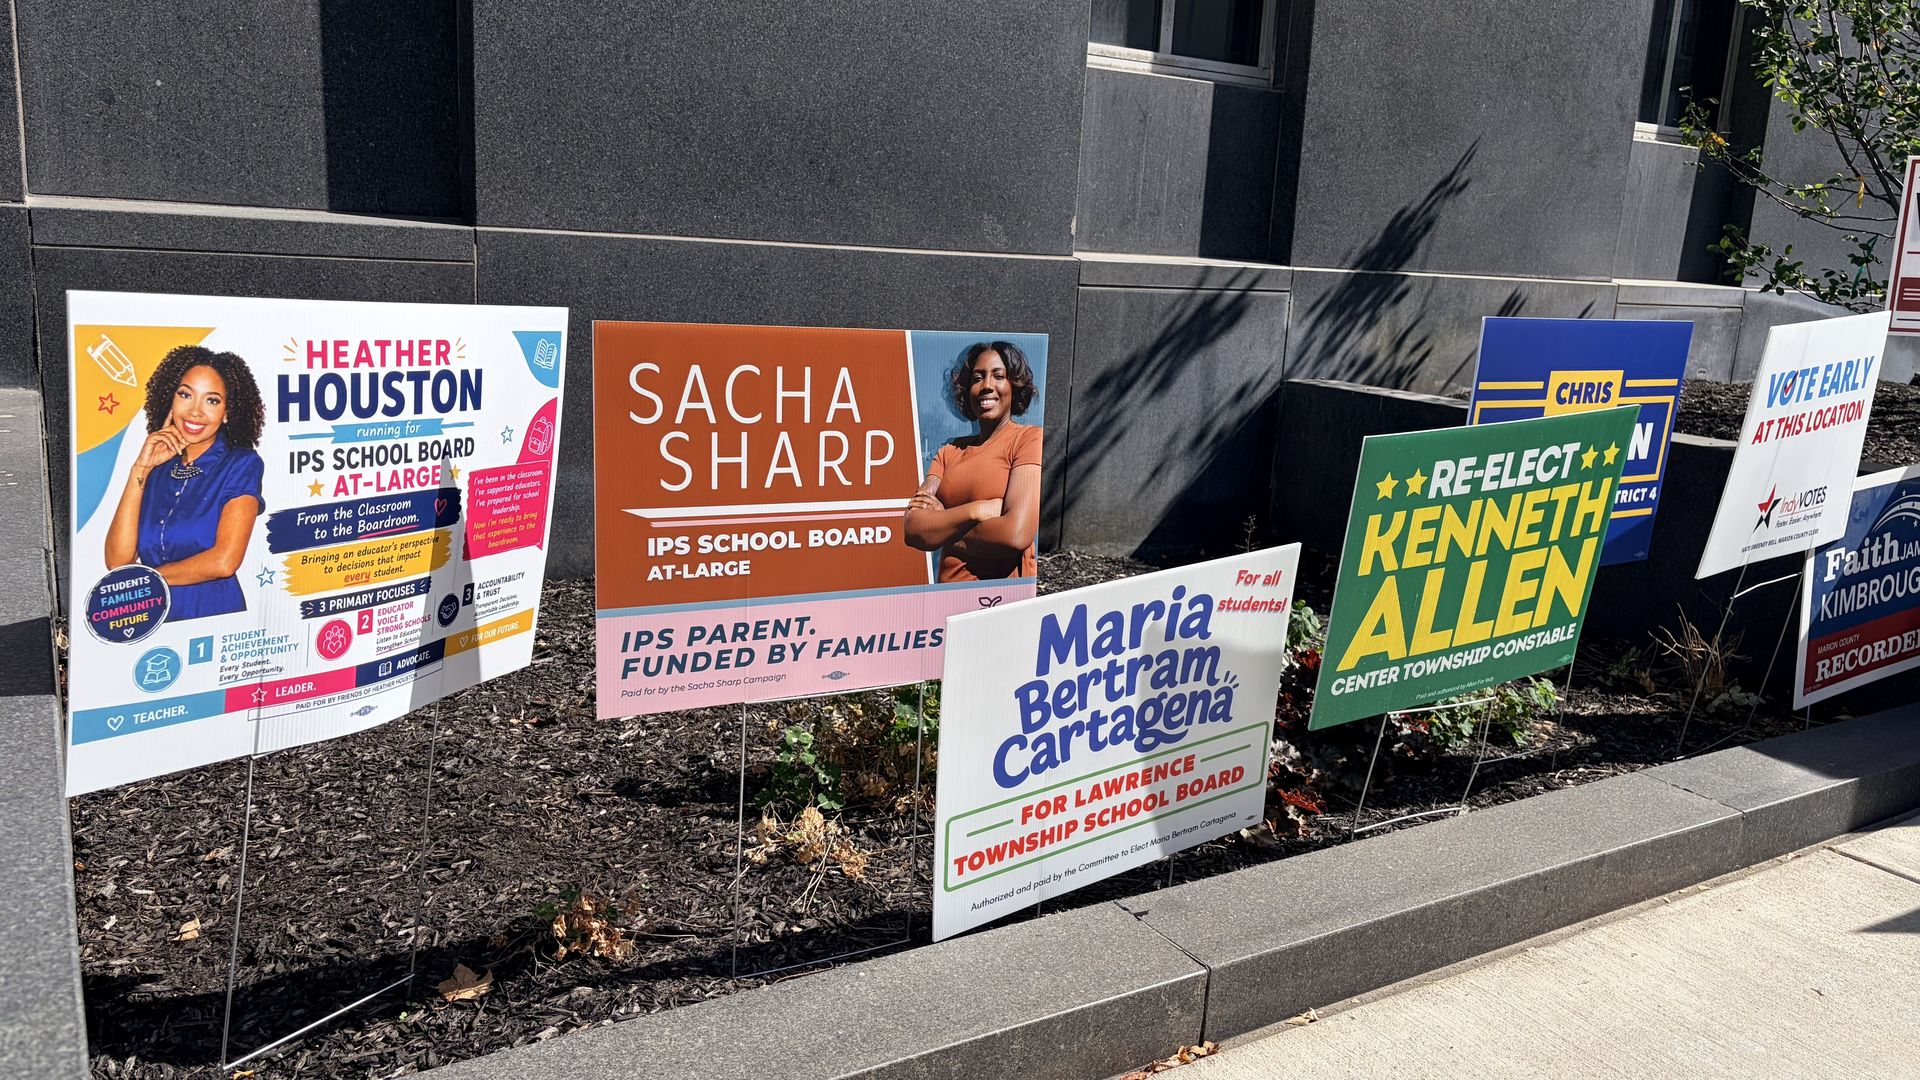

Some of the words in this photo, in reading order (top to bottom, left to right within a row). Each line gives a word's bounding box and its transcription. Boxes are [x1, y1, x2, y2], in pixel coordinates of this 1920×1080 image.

[307, 340, 451, 368] HEATHER
[629, 362, 861, 425] SACHA
[1556, 381, 1613, 405] CHRIS
[1767, 367, 1819, 408] VOTE
[1818, 356, 1875, 398] EARLY
[278, 368, 483, 422] HOUSTON
[356, 424, 400, 438] running
[406, 422, 421, 434] for
[1752, 420, 1774, 445] AT
[1775, 413, 1806, 440] THIS
[1805, 399, 1865, 433] LOCATION
[290, 449, 325, 474] IPS
[332, 443, 412, 470] SCHOOL
[418, 437, 474, 462] BOARD
[659, 430, 895, 492] SHARP
[333, 465, 441, 497] AT-LARGE
[474, 477, 483, 485] I've
[485, 475, 498, 483] been
[507, 472, 516, 480] the
[1428, 442, 1581, 499] RE-ELECT
[475, 487, 484, 496] I've
[487, 483, 513, 494] supported
[476, 499, 485, 507] I've
[487, 494, 511, 506] prepared
[523, 490, 539, 498] school
[1614, 487, 1648, 504] TRICT
[1649, 487, 1657, 500] 4
[297, 512, 328, 526] From
[334, 507, 352, 520] the
[358, 500, 411, 516] Classroom
[473, 522, 486, 530] Now
[499, 516, 514, 525] ready
[523, 512, 537, 520] bring
[314, 528, 326, 539] to
[333, 524, 352, 537] the
[358, 514, 419, 533] Boardroom.
[473, 532, 485, 541] that
[488, 526, 516, 537] experience
[1357, 477, 1613, 577] KENNETH
[302, 553, 339, 565] Bringing
[357, 542, 398, 556] educator's
[400, 535, 439, 551] perspective
[647, 536, 691, 557] IPS
[697, 529, 801, 554] SCHOOL
[809, 525, 892, 547] BOARD
[324, 565, 333, 573] to
[337, 558, 374, 572] decisions
[378, 556, 394, 565] that
[396, 550, 421, 562] impact
[1824, 532, 1899, 582] Faith
[1900, 540, 1920, 560] JAM
[344, 571, 370, 582] every
[374, 566, 404, 578] student.
[646, 560, 751, 581] AT-LARGE
[1236, 570, 1261, 586] For
[1263, 570, 1282, 586] all
[100, 576, 151, 594] STUDENTS
[101, 587, 151, 607] FAMILIES
[319, 601, 326, 612] 3
[329, 592, 374, 611] PRIMARY
[377, 583, 416, 601] FOCUSES
[466, 588, 471, 601] 3
[477, 572, 525, 590] ACCOUNTABILITY
[483, 587, 501, 598] TRUST
[1820, 567, 1920, 622] KIMBROUG
[92, 596, 163, 622] COMMUNITY
[361, 615, 369, 629] 2
[378, 601, 414, 616] EDUCATOR
[1217, 596, 1287, 612] students!
[1336, 536, 1599, 672] ALLEN
[109, 613, 149, 630] FUTURE
[377, 623, 403, 635] STRONG
[405, 614, 431, 628] SCHOOLS
[378, 615, 398, 626] VOICE
[1036, 584, 1214, 677] Maria
[197, 642, 204, 657] 1
[222, 629, 267, 643] STUDENT
[221, 635, 289, 653] ACHIEVEMENT
[376, 636, 391, 644] Listen
[471, 633, 483, 643] FOR
[485, 627, 496, 638] OUR
[621, 628, 674, 653] IPS
[687, 616, 816, 647] PARENT.
[1818, 642, 1838, 654] MARION
[1840, 633, 1860, 647] COUNTY
[220, 655, 226, 663] &
[231, 643, 299, 661] OPPORTUNITY
[397, 650, 431, 669] ADVOCATE.
[621, 647, 756, 680] FUNDED
[767, 642, 809, 664] BY
[816, 627, 944, 659] FAMILIES
[1330, 666, 1400, 696] CENTER
[1403, 645, 1491, 681] TOWNSHIP
[1492, 623, 1576, 660] CONSTABLE
[219, 672, 238, 681] Every
[241, 666, 285, 677] Opportunity.
[220, 662, 239, 673] Every
[242, 659, 271, 668] Student.
[275, 682, 316, 697] LEADER.
[337, 691, 362, 701] FRIENDS
[372, 680, 395, 692] HEATHER
[396, 673, 417, 683] HOUSTON
[621, 689, 642, 698] Paid
[644, 687, 656, 696] for
[658, 685, 669, 695] by
[671, 684, 685, 692] the
[687, 681, 714, 691] Sacha
[717, 678, 741, 689] Sharp
[743, 673, 786, 685] Campaign
[1014, 644, 1222, 735] Bertram
[133, 705, 188, 724] TEACHER.
[992, 684, 1235, 789] Cartagena
[1020, 794, 1068, 826] FOR
[1075, 754, 1196, 808] LAWRENCE
[954, 821, 1078, 876] TOWNSHIP
[1084, 794, 1170, 833] SCHOOL
[1175, 765, 1244, 802] BOARD
[971, 886, 1014, 911] Authorized
[1016, 882, 1031, 894] and
[1033, 874, 1051, 890] paid
[1053, 872, 1062, 883] by
[1064, 868, 1076, 877] the
[1078, 852, 1120, 872] Committee
[1121, 848, 1128, 856] to
[1130, 841, 1148, 854] Elect
[1150, 834, 1170, 846] Maria
[1172, 824, 1198, 838] Bertram
[1200, 812, 1236, 828] Cartagena
